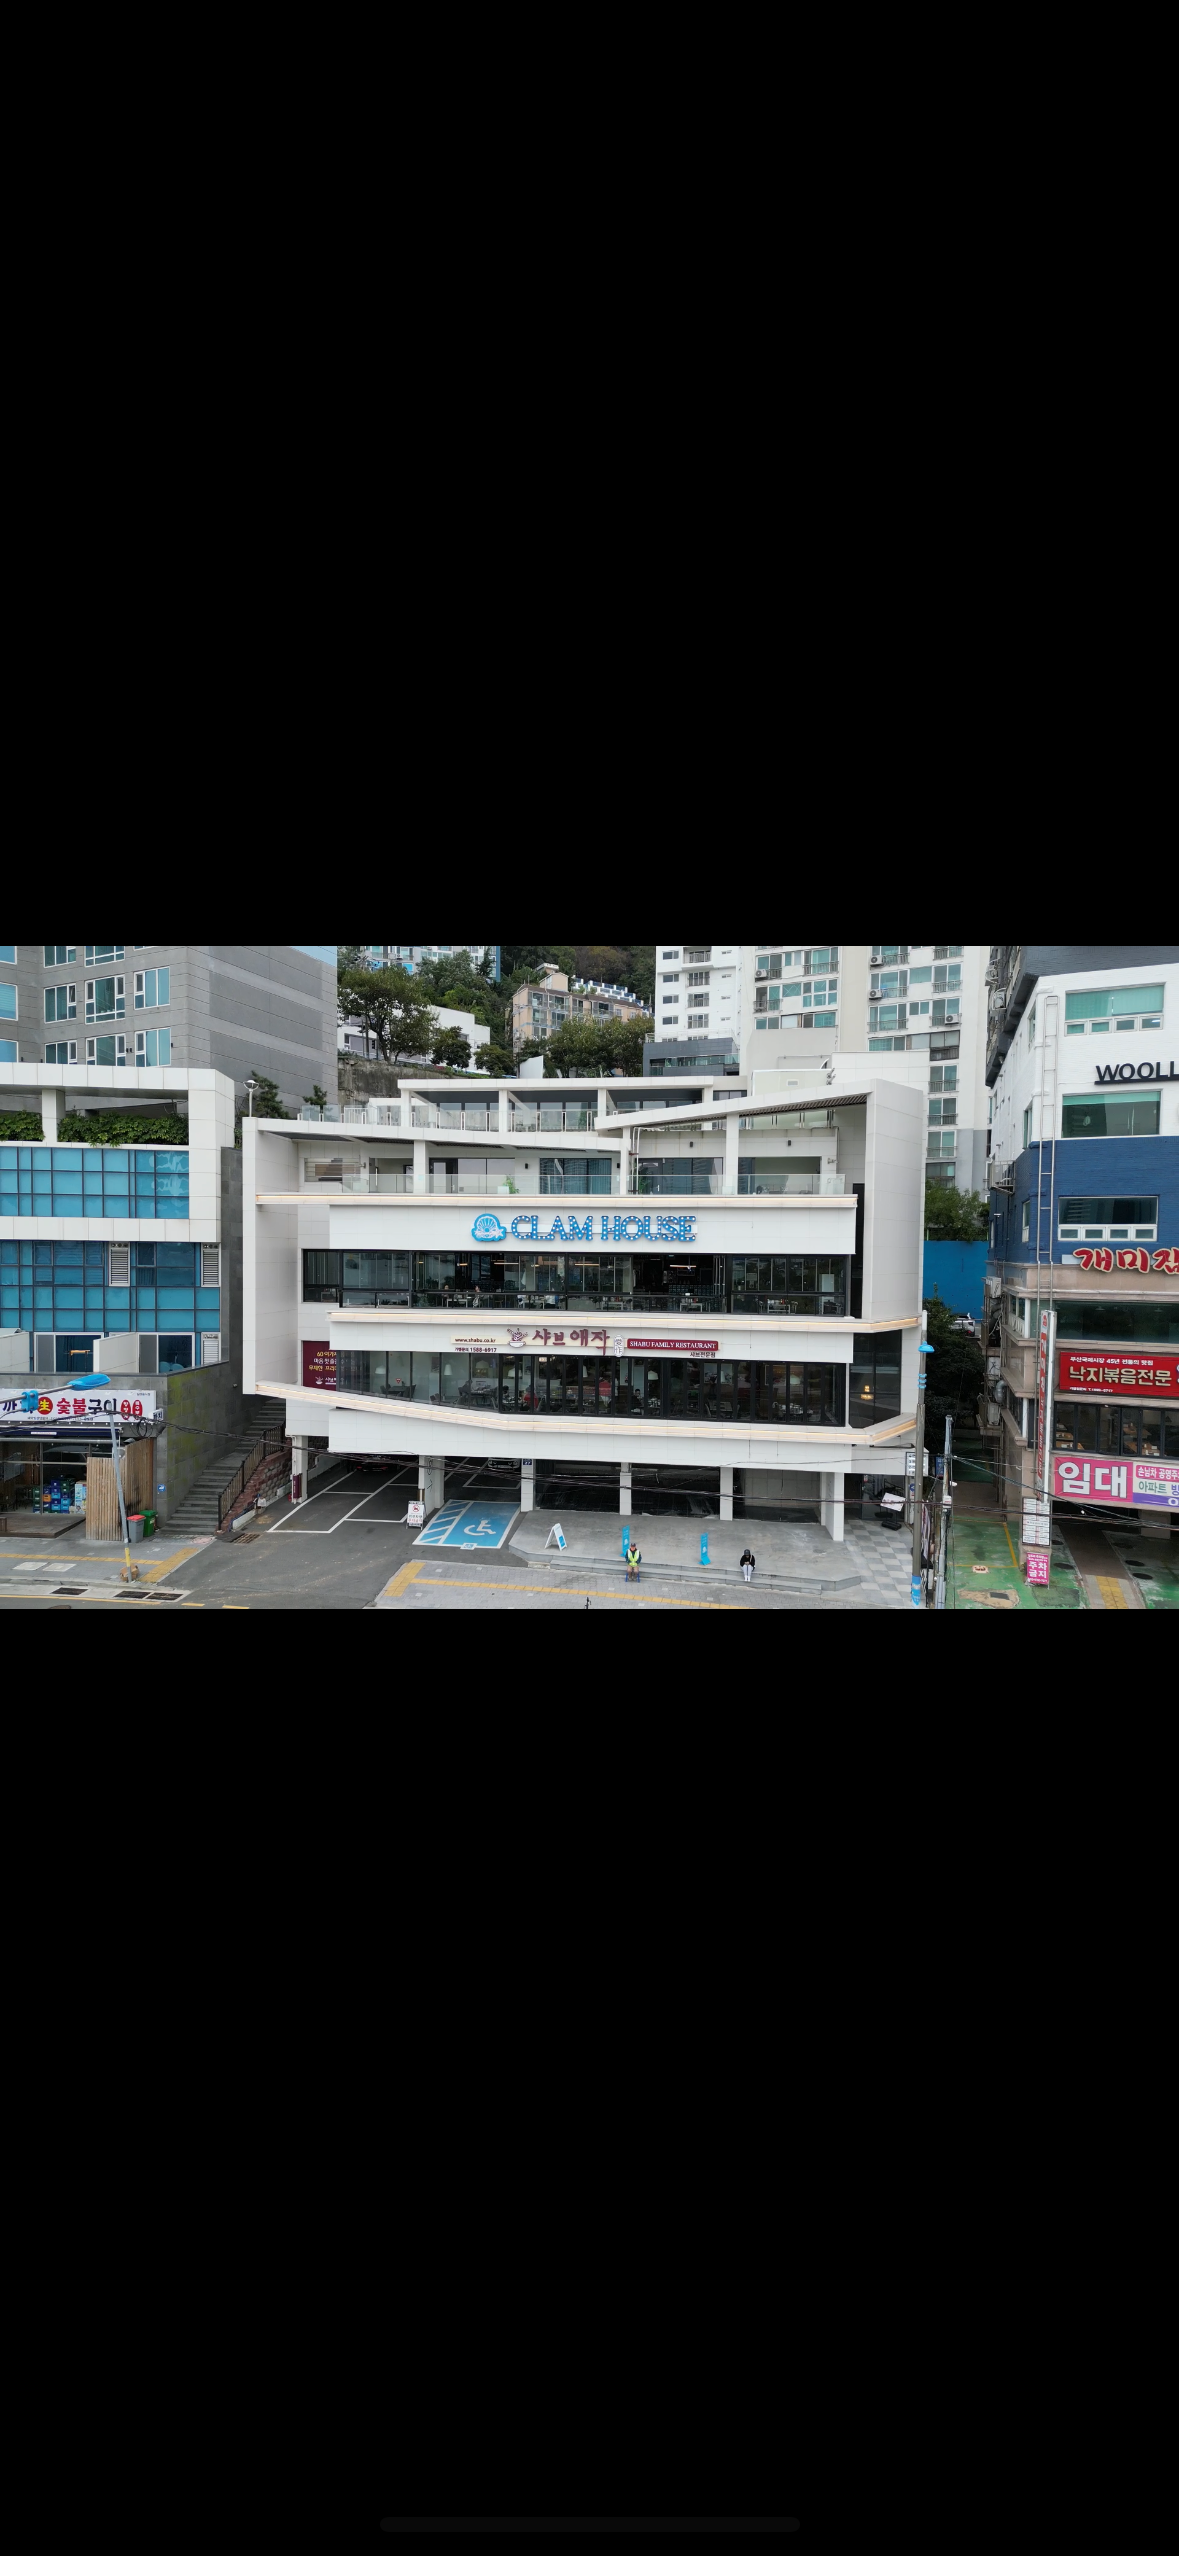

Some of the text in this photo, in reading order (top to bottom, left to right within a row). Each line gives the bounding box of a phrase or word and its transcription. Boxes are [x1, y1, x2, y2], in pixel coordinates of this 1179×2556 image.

[511, 1215, 696, 1241] CLAM HOUSE
[1069, 1366, 1172, 1387] 낙지볶음전문
[57, 1398, 118, 1415] 숯불구이
[1058, 1461, 1128, 1499] 임대
[1137, 1466, 1179, 1480] 손님차 공영주
[1138, 1481, 1168, 1494] 아파트
[1028, 1560, 1048, 1571] 주차
[1028, 1569, 1048, 1579] 금지
